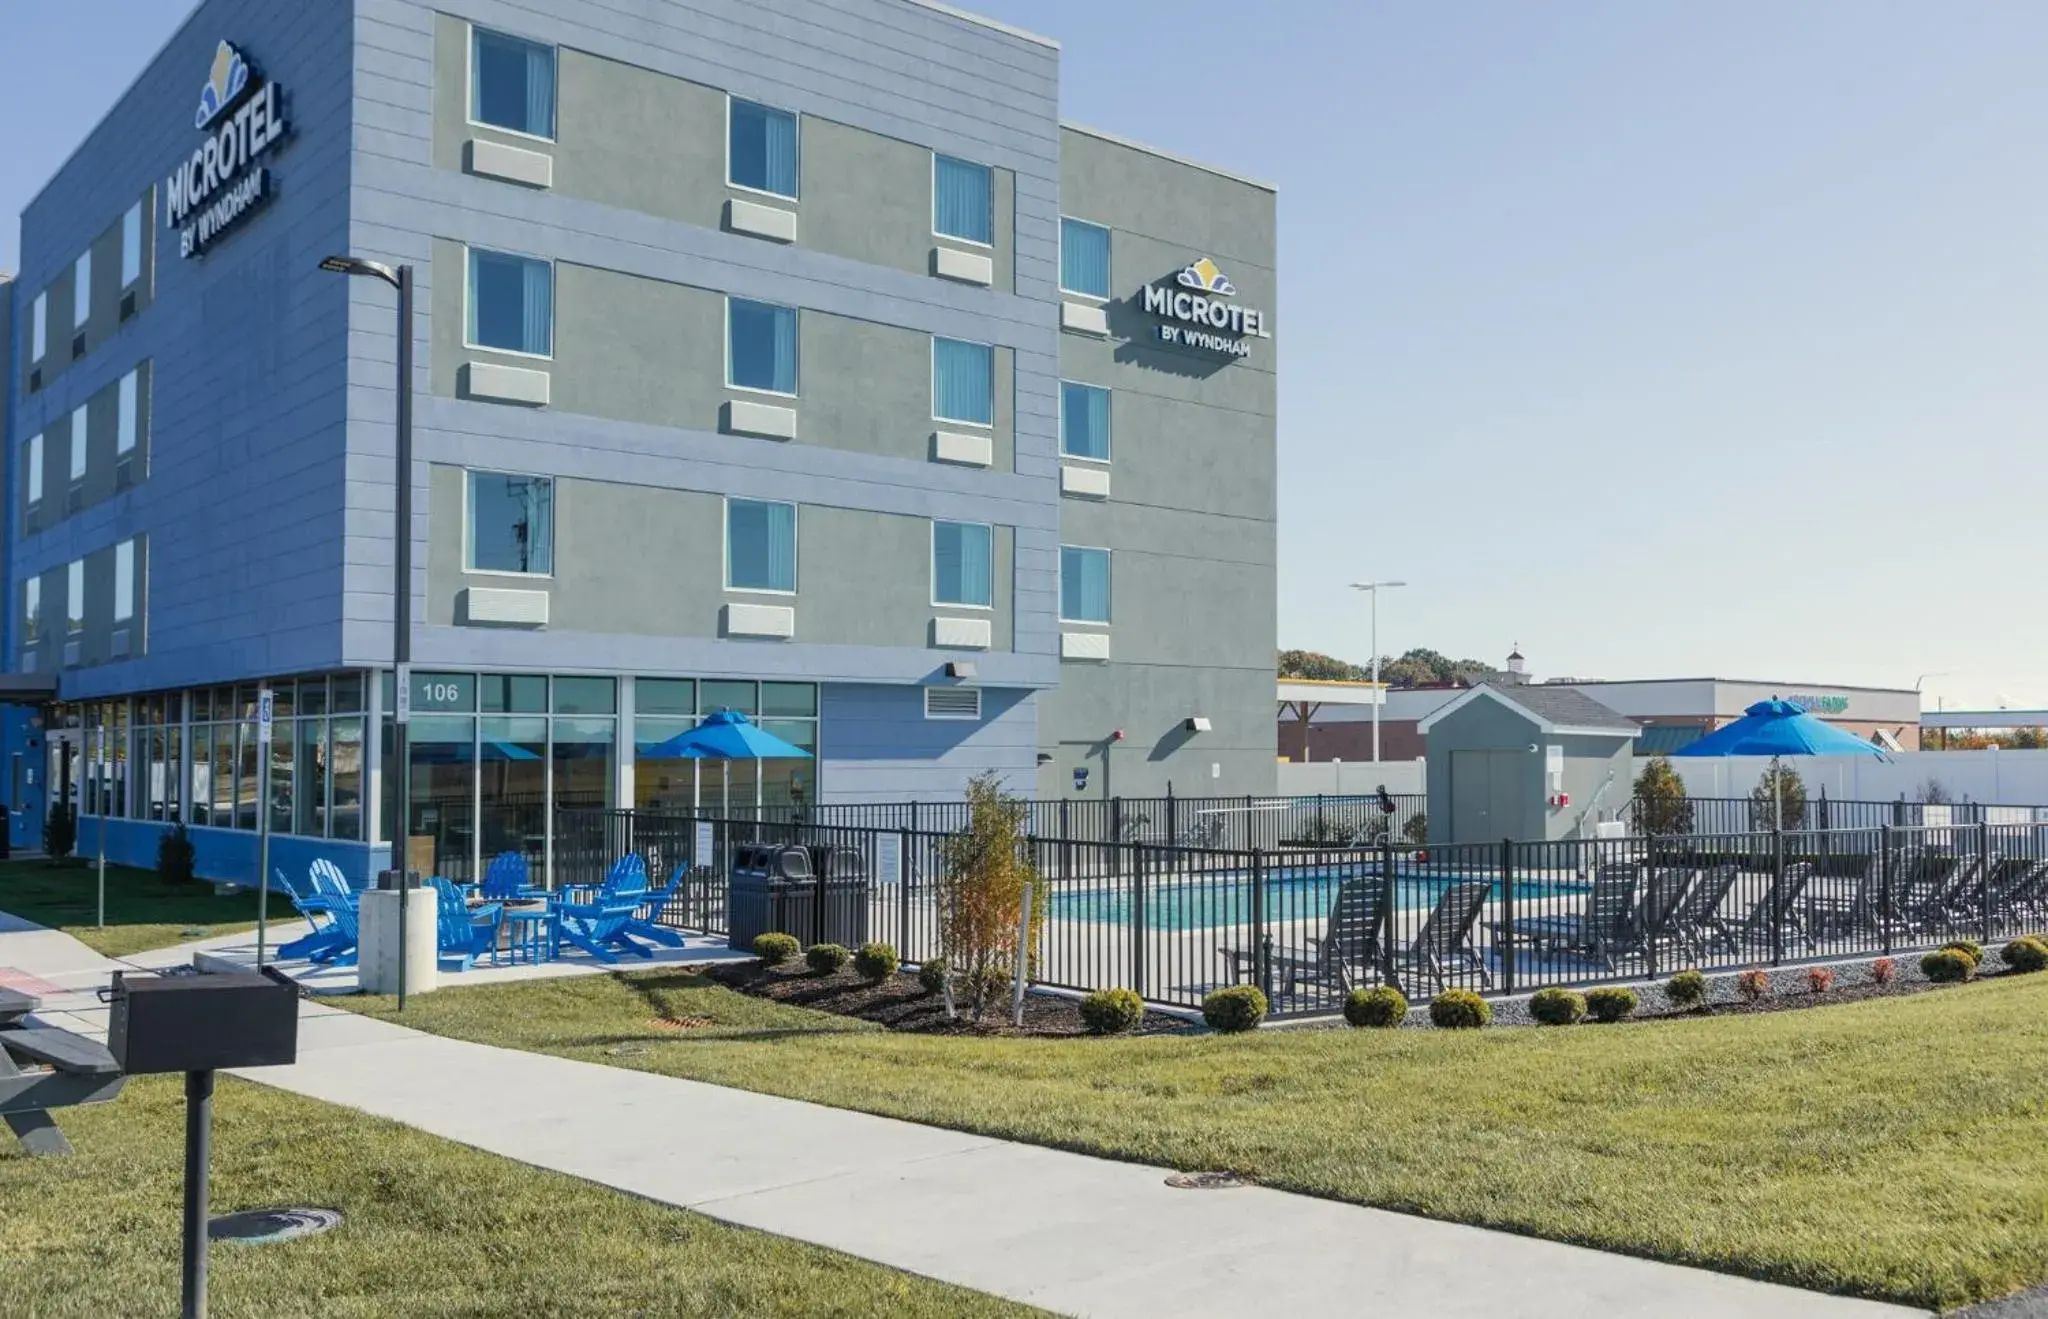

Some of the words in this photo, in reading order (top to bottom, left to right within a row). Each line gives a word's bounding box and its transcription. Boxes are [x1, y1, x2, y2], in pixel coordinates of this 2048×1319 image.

[167, 81, 282, 228] MICROTEL
[181, 222, 197, 258] BY
[199, 167, 262, 244] WYNDHAM
[1145, 284, 1271, 339] MICROTEL
[1162, 325, 1180, 342] BY
[1184, 329, 1250, 357] WYNDHAM
[423, 683, 459, 702] 106
